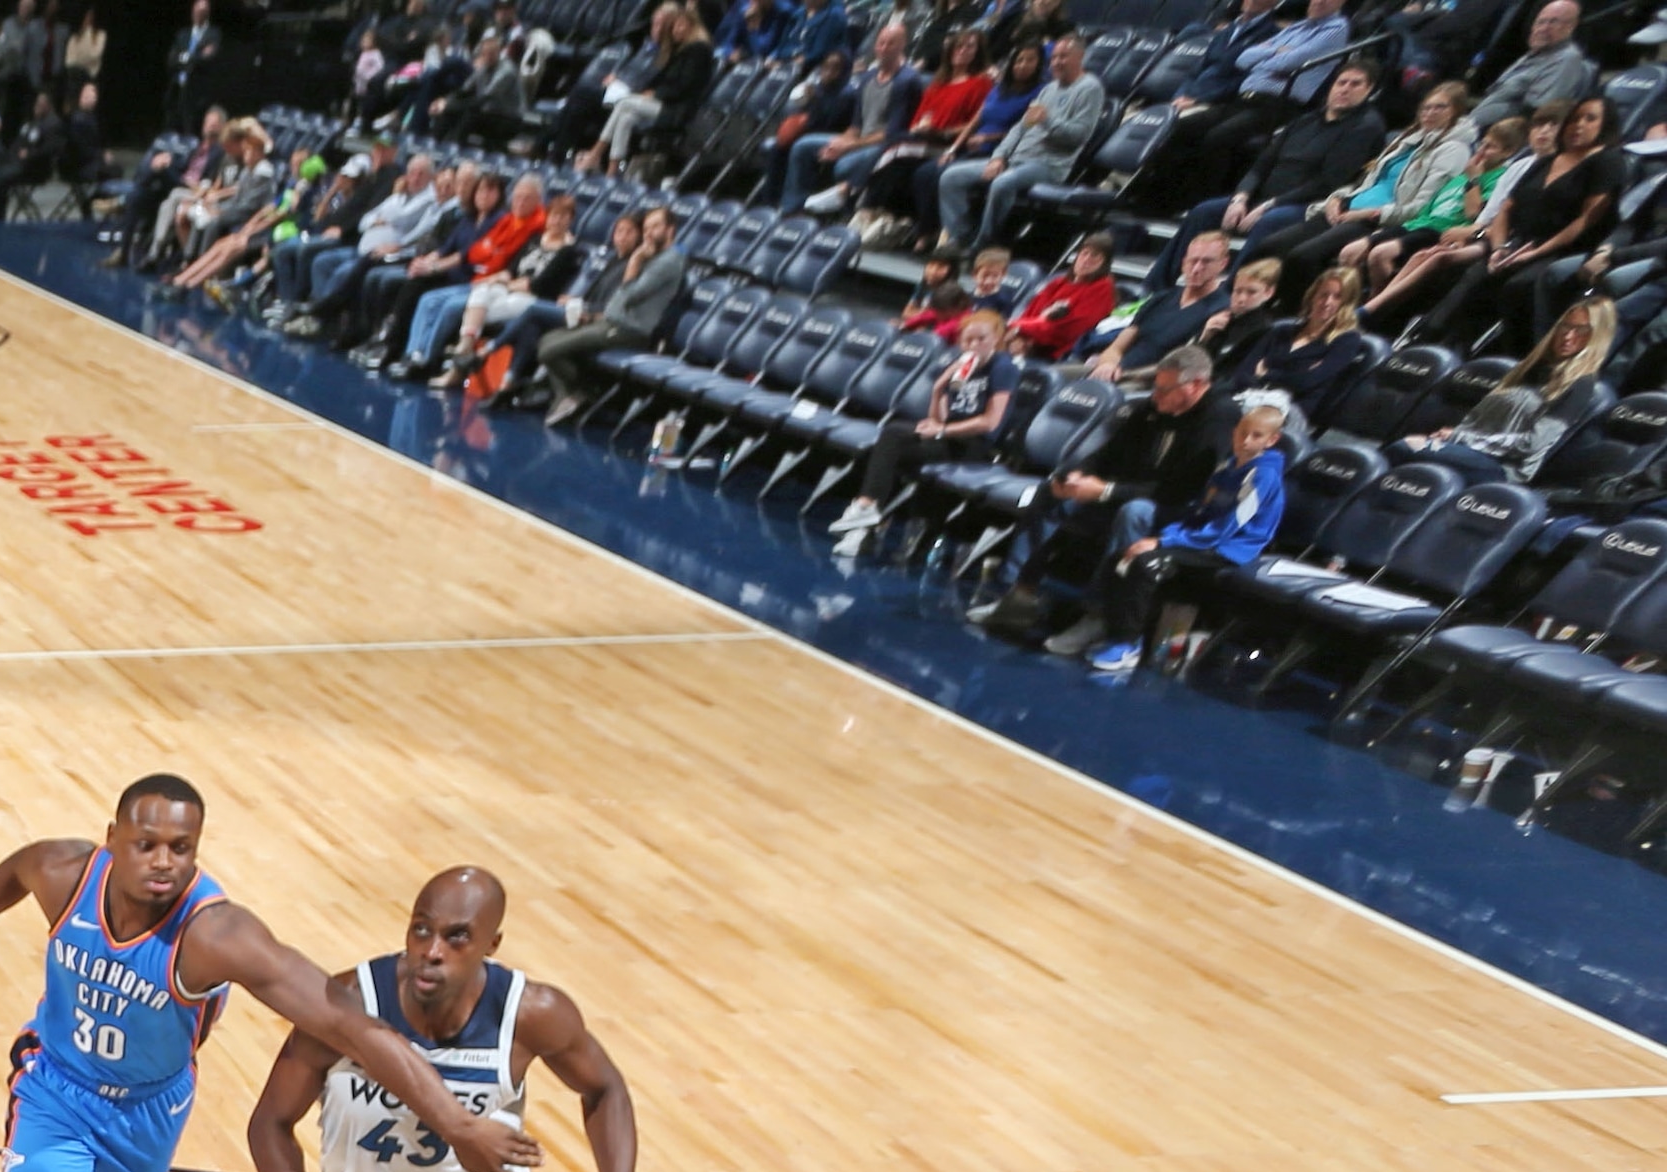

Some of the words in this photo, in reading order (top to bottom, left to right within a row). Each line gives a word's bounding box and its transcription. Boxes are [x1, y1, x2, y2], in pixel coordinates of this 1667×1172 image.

[45, 434, 264, 533] CENTER
[54, 937, 170, 1012] OKLAHOMA
[78, 982, 128, 1017] CITY
[72, 1006, 127, 1063] 30
[350, 1077, 491, 1116] WOES
[357, 1119, 450, 1168] 43
